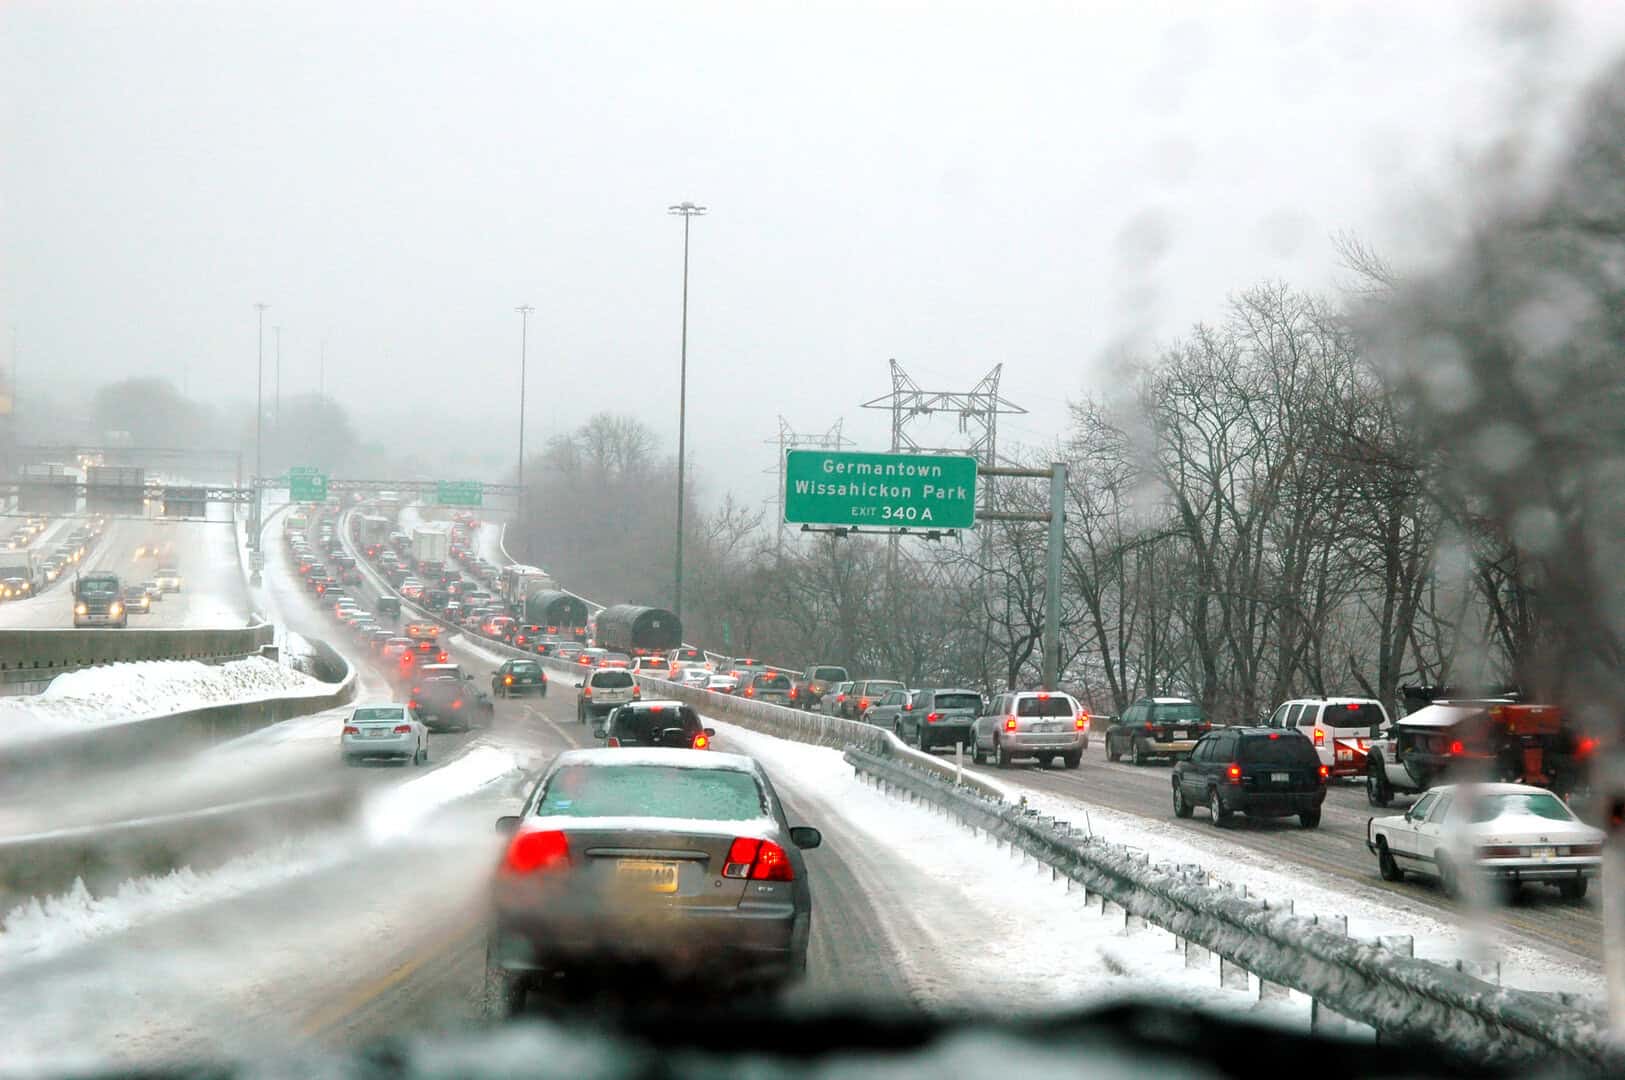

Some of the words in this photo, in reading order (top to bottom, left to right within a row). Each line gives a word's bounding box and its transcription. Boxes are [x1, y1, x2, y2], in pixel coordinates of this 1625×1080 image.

[823, 460, 942, 477] Germantown
[796, 480, 911, 498] Wissahickon
[923, 484, 966, 500] Park
[851, 507, 876, 517] EXIT
